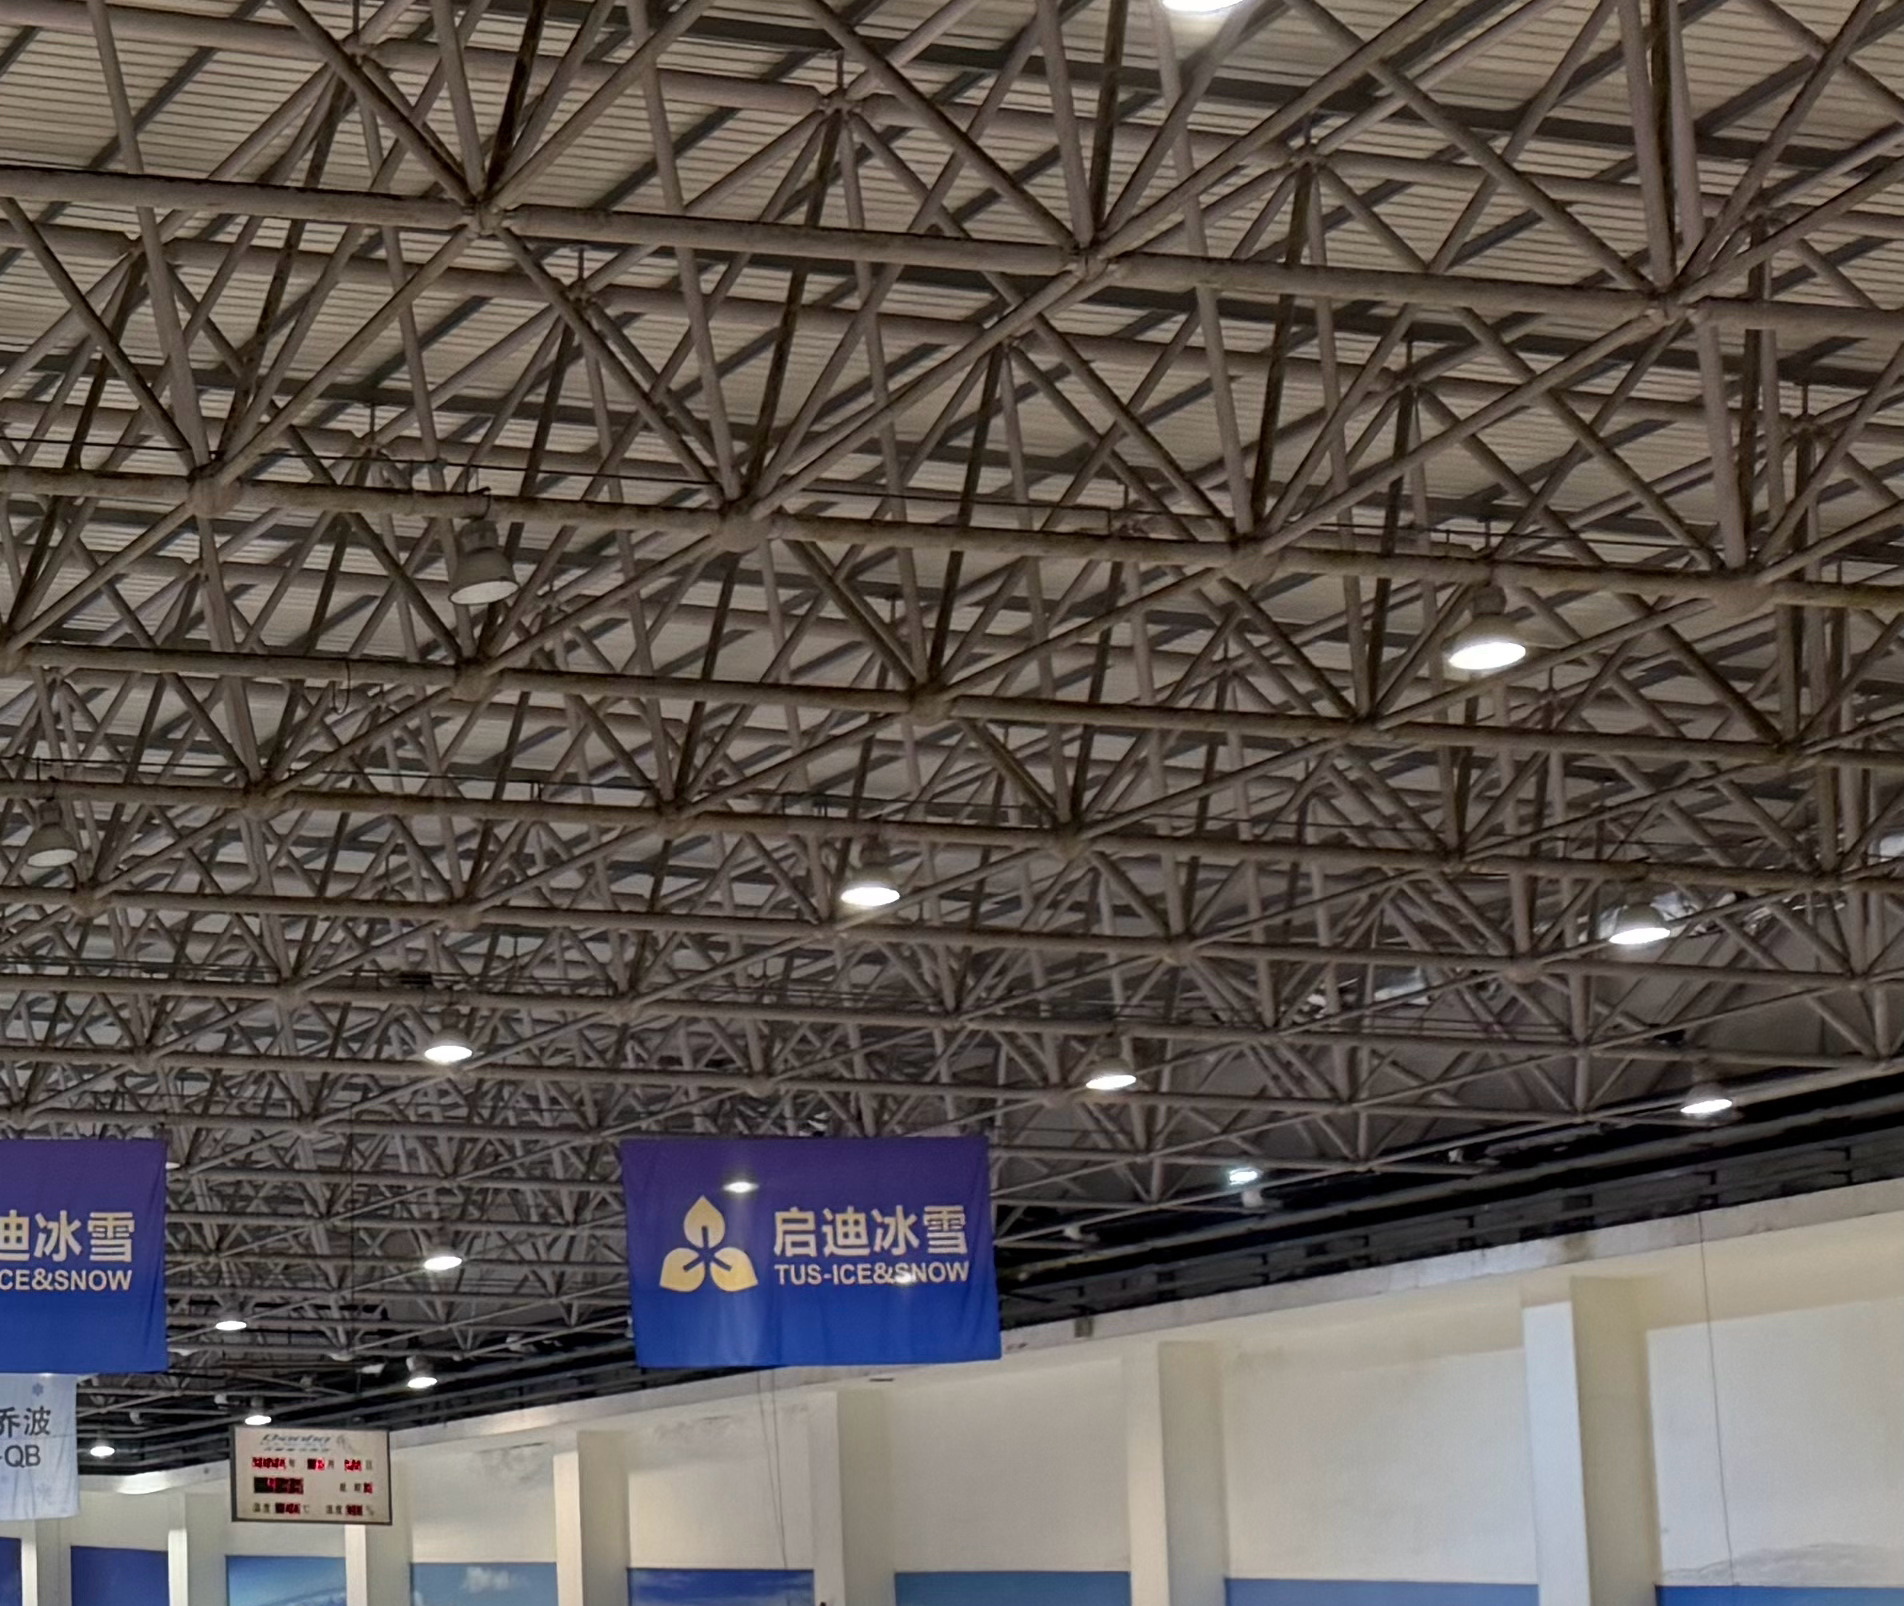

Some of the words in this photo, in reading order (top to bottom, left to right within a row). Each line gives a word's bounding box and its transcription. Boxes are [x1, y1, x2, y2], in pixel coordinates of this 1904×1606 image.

[774, 1205, 968, 1257] 启迪冰雪
[774, 1260, 969, 1286] TUS-ICE&SNOW
